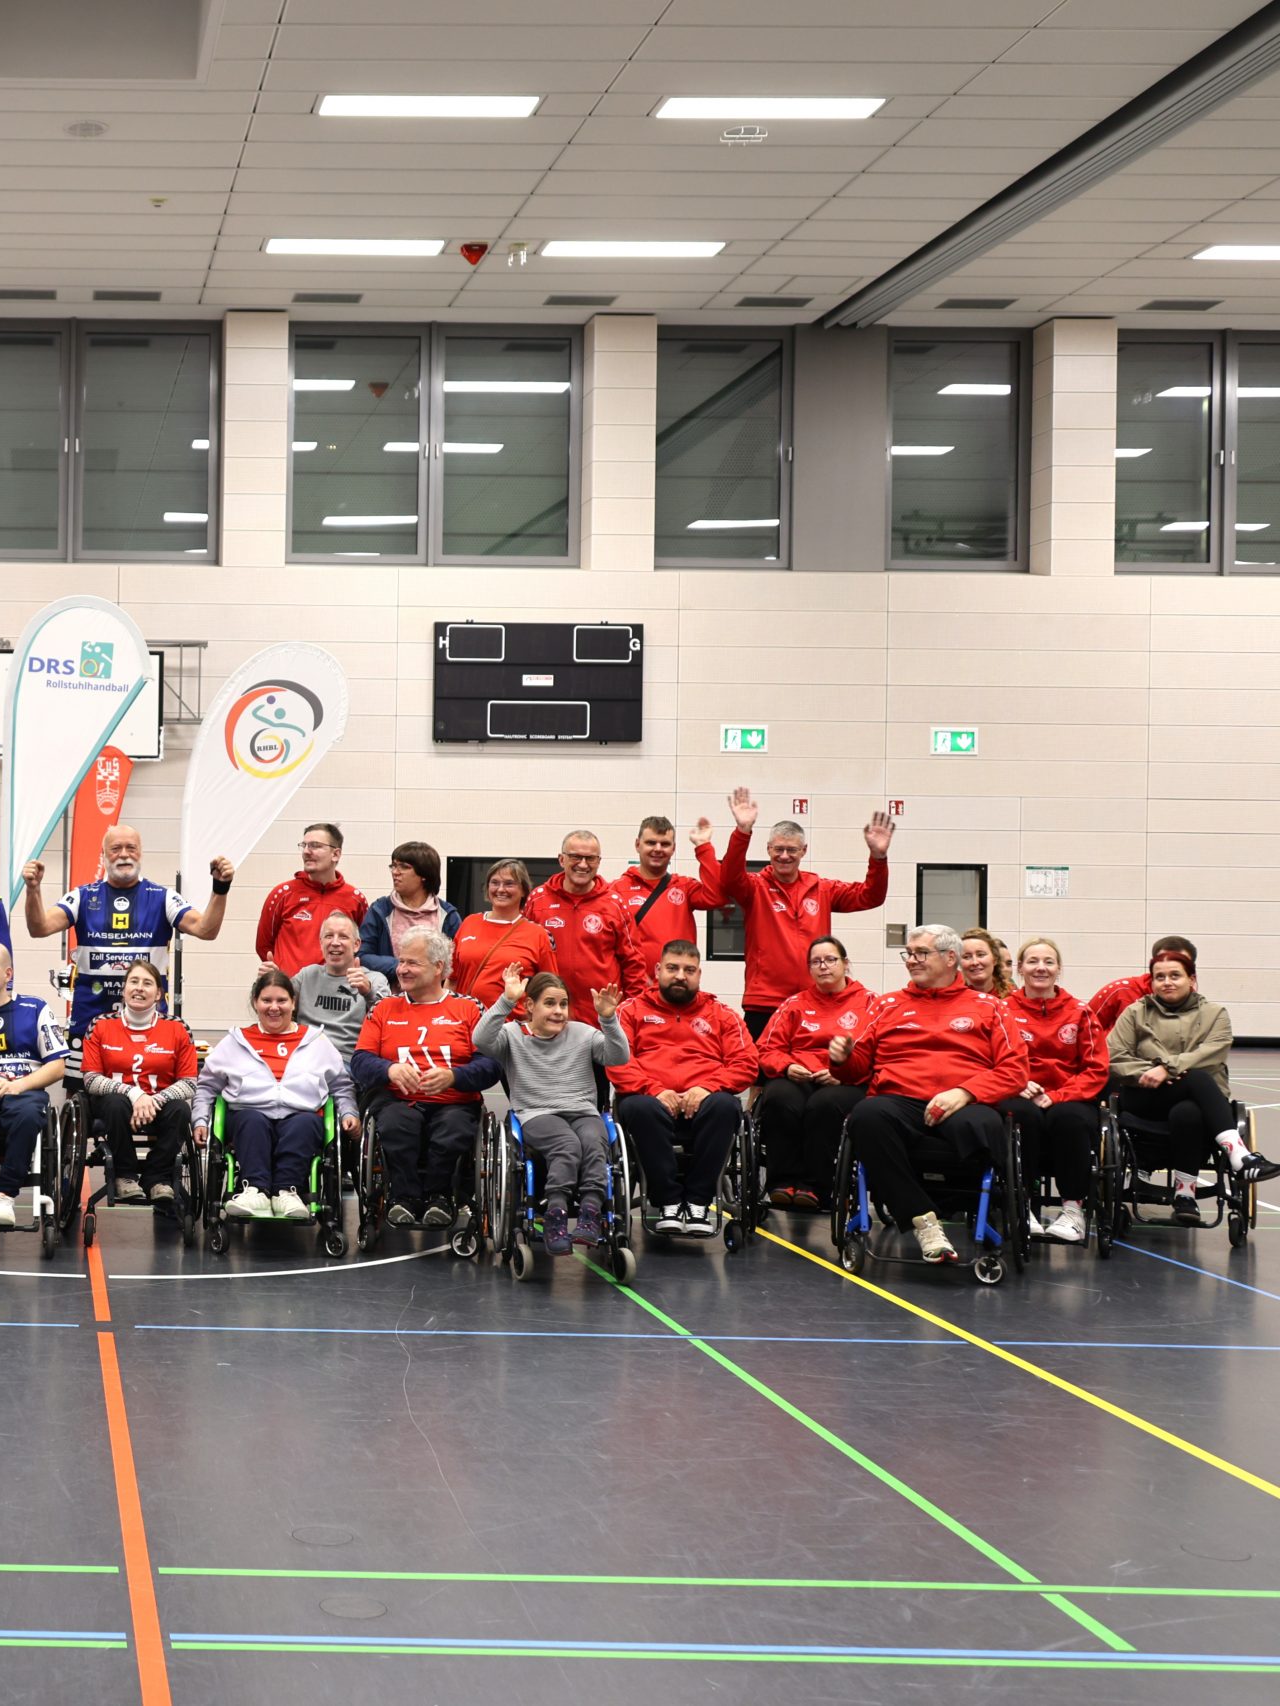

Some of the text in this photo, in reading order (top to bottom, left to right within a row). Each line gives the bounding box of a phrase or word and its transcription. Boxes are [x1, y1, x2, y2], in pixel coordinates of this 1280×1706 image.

[439, 636, 449, 648] H
[629, 639, 640, 651] G
[28, 657, 75, 675] DRS
[46, 680, 129, 692] Rollstuhlhandball
[116, 916, 126, 926] H
[88, 931, 153, 940] HASSELMANN
[91, 953, 105, 961] Zoll
[106, 953, 134, 961] Service
[315, 995, 351, 1012] PUMA
[417, 1026, 428, 1045] 7
[277, 1042, 288, 1057] 6
[131, 1053, 144, 1073] 2
